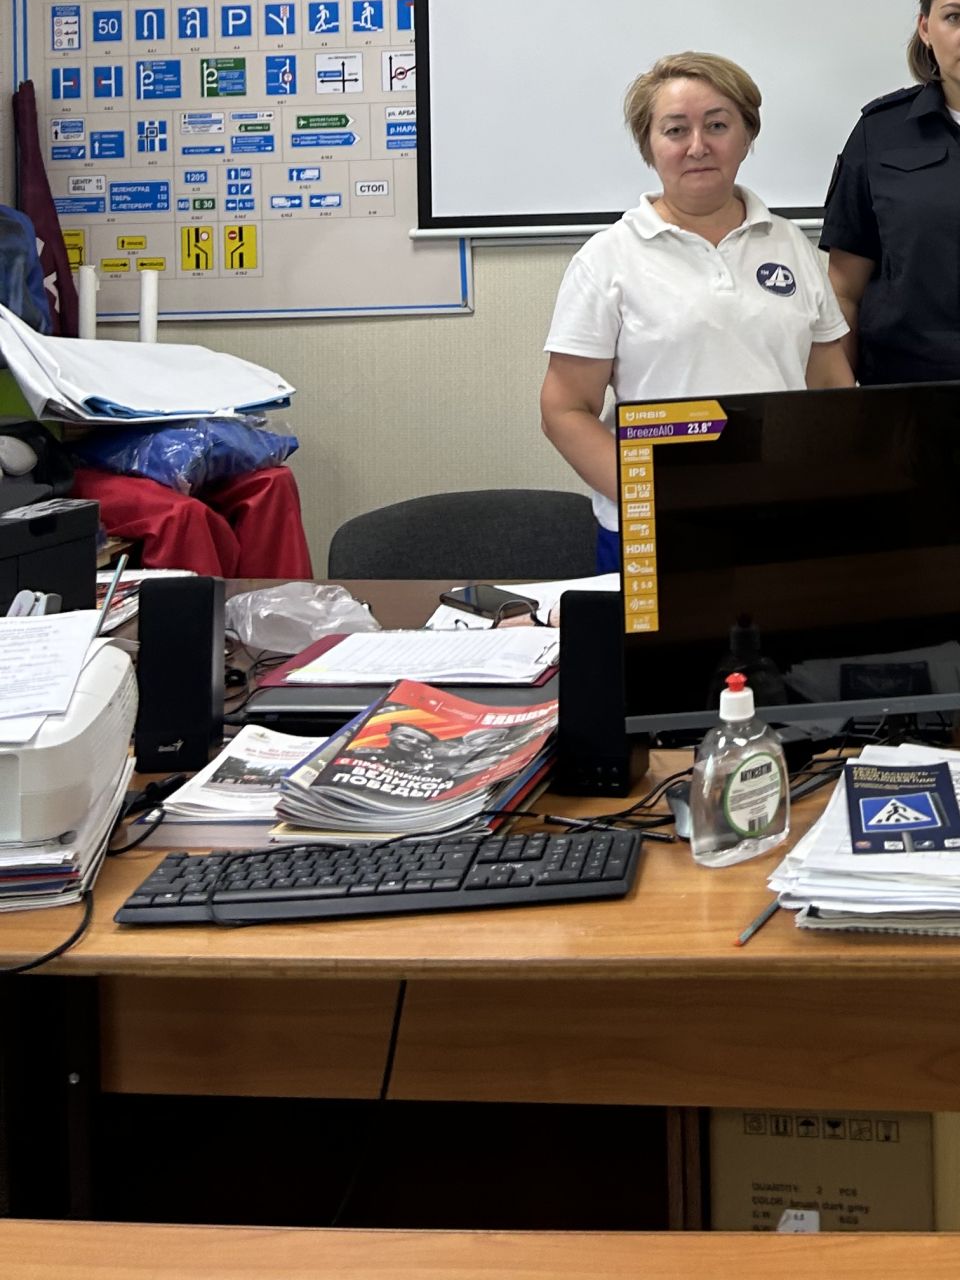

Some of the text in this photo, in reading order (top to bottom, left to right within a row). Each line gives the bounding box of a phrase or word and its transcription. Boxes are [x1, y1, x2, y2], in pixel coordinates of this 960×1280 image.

[98, 19, 118, 34] 50
[227, 9, 246, 35] P
[360, 184, 384, 193] СТОП
[627, 424, 674, 439] BreezeAIO
[639, 448, 650, 456] HD
[629, 467, 646, 477] IPS
[626, 543, 654, 554] HDMI
[351, 766, 455, 790] ВЕЛИКОЙ
